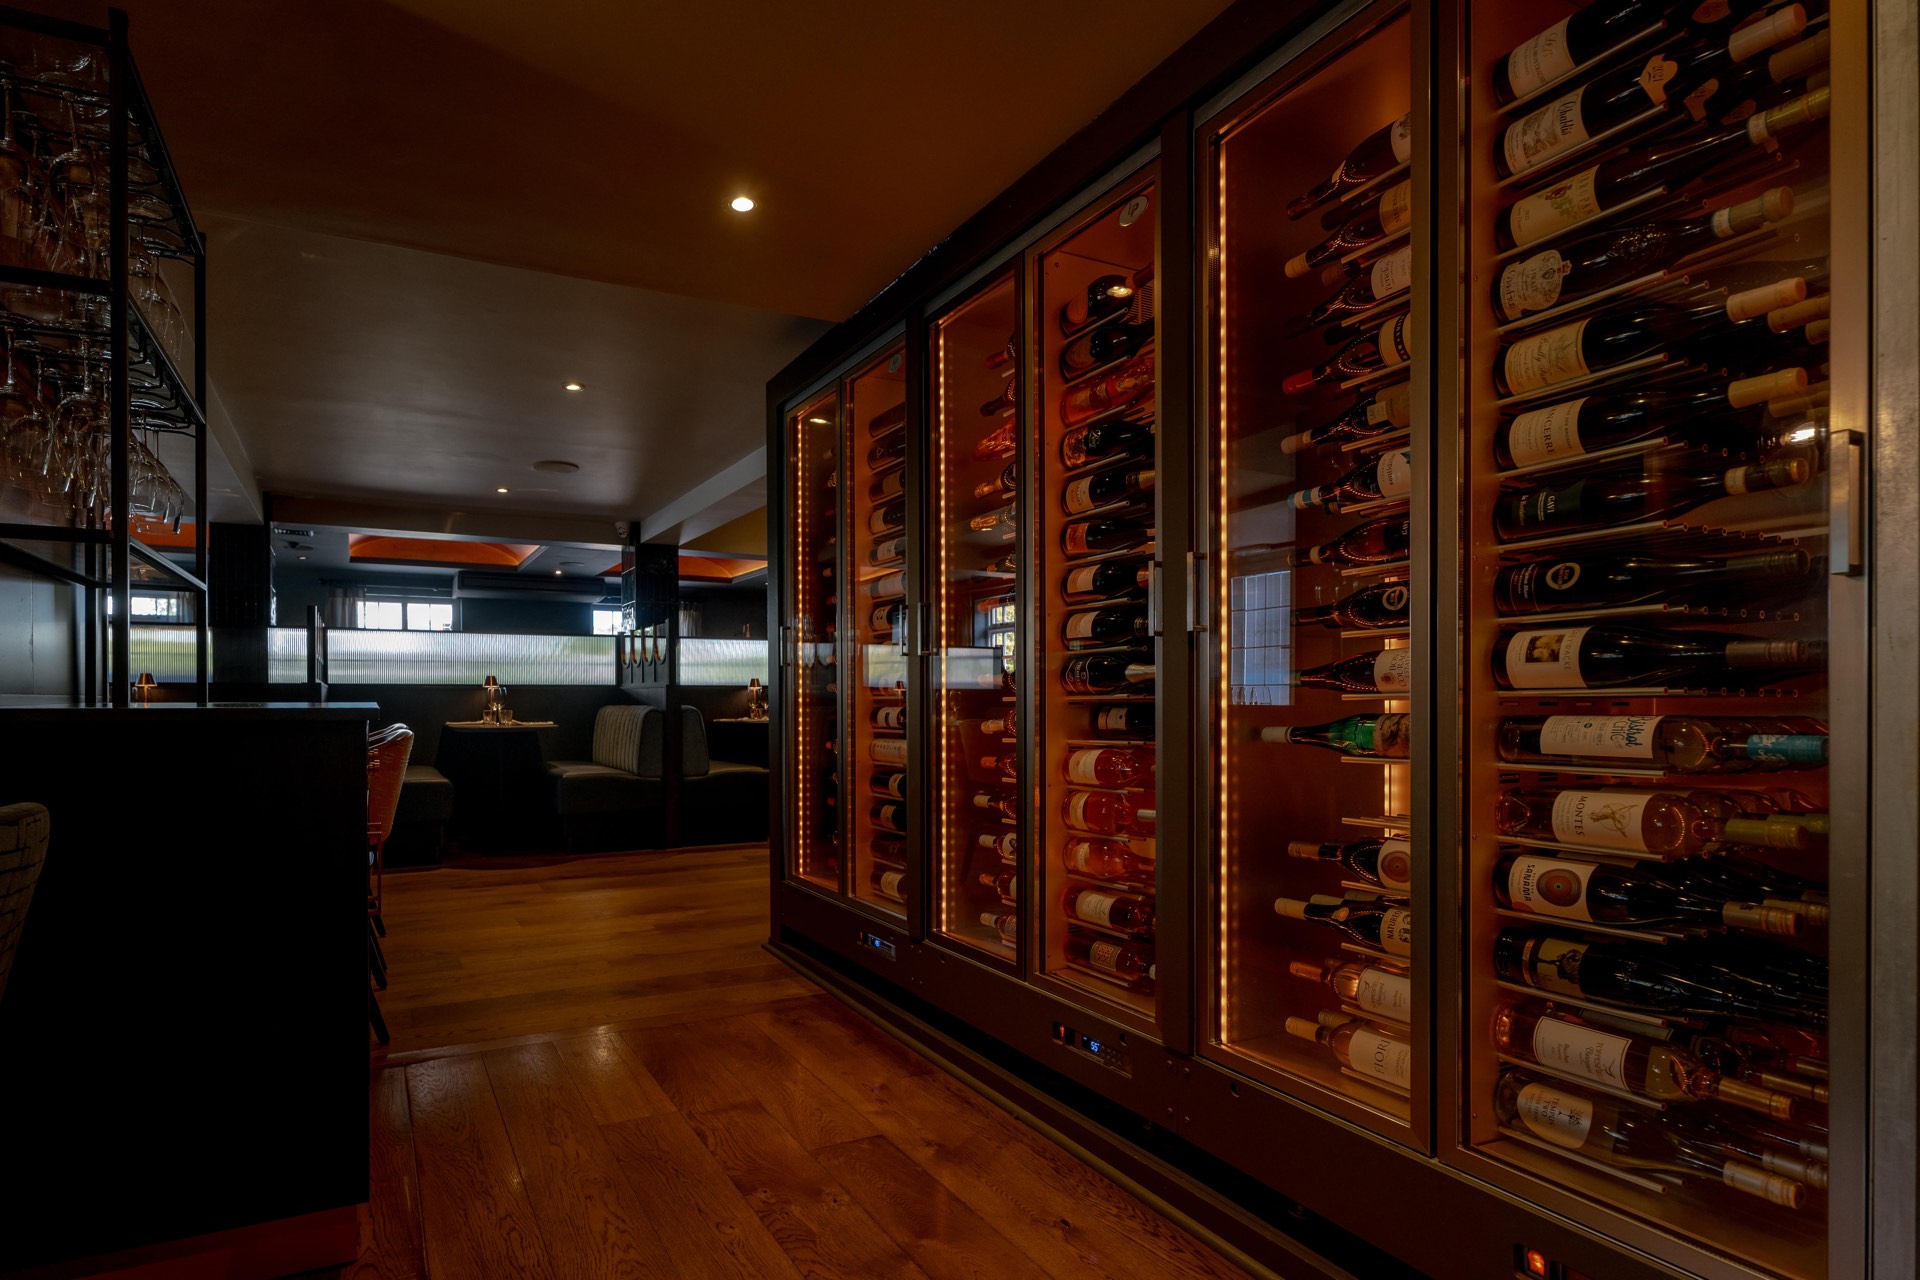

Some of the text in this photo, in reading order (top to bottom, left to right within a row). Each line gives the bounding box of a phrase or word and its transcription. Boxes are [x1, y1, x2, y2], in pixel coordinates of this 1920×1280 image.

[1559, 101, 1576, 136] Chablis
[1625, 716, 1653, 747] Bistrot
[1574, 795, 1589, 836] MONTES
[1522, 863, 1535, 902] SANAMA
[1374, 1039, 1391, 1074] FIORI
[1541, 1100, 1551, 1117] TWO
